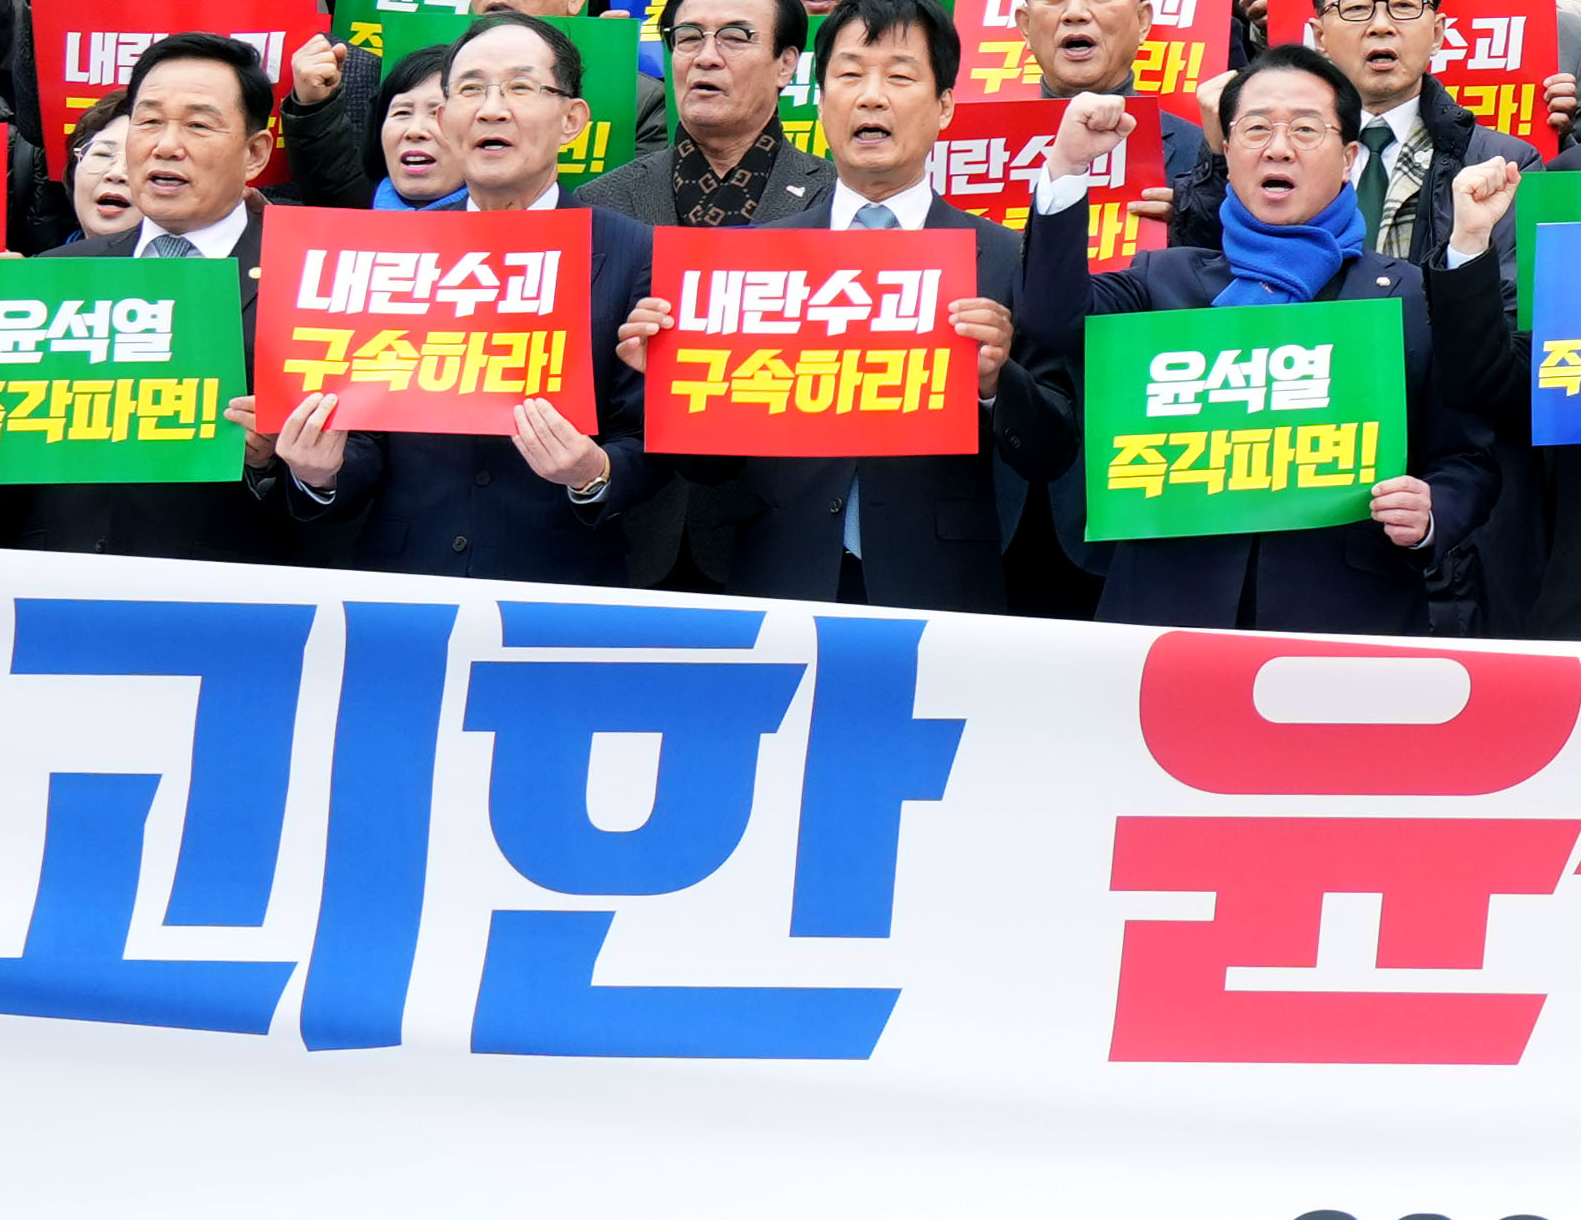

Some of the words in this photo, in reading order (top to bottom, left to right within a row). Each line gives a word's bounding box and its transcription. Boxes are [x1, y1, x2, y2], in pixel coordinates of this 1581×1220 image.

[299, 250, 559, 316] 내란수괴
[680, 269, 942, 336] 내란수괴
[284, 327, 561, 394] 구속하라!
[671, 347, 946, 416] 구속하라!
[1146, 342, 1332, 418] 윤석열
[1108, 421, 1378, 496] 즉각파면!
